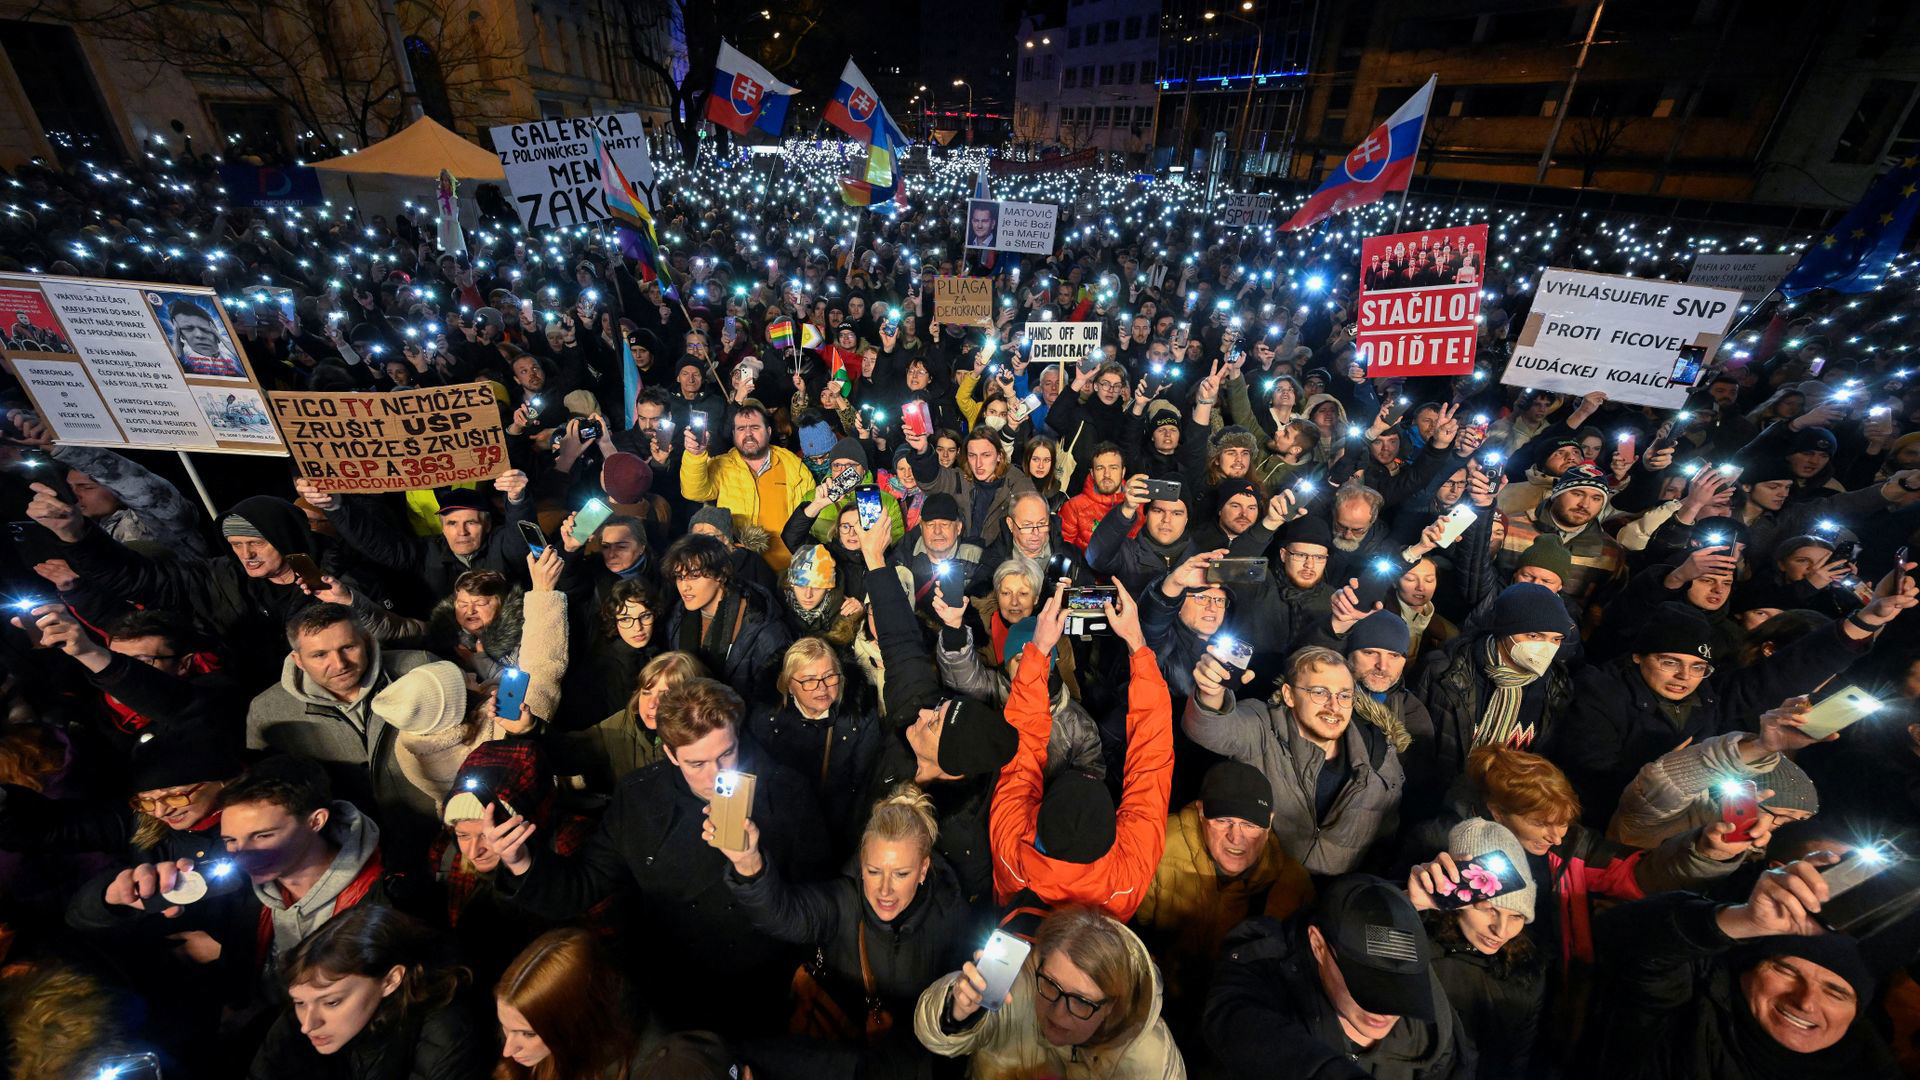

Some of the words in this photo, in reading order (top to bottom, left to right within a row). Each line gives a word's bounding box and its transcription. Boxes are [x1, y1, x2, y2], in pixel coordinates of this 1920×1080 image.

[499, 151, 511, 165] Z
[604, 136, 640, 150] HATY
[548, 158, 601, 188] MEN
[517, 180, 656, 232] ZÁKY
[1229, 194, 1246, 207] SME
[1247, 195, 1254, 207] V
[1002, 217, 1011, 227] je
[1014, 219, 1028, 228] bič
[1014, 240, 1045, 250] SMER
[1017, 230, 1050, 240] MAFIU
[1695, 263, 1717, 271] MAFIA
[937, 279, 988, 295] PLIAGA
[936, 305, 990, 317] DEMOKRACIU
[954, 295, 967, 304] ZA
[1361, 292, 1477, 327] STAČILO!
[1546, 281, 1669, 308] VYHLASUJEME
[1672, 298, 1727, 319] SNP
[109, 308, 120, 316] DO
[1028, 326, 1052, 340] HANDS
[1059, 326, 1075, 340] OFF
[1083, 326, 1098, 340] OUR
[1546, 322, 1601, 340] PROTI
[1610, 330, 1687, 351] FICOVEJ
[95, 348, 110, 356] VÁS
[1360, 335, 1472, 367] ODÍĎTE!
[137, 370, 152, 378] VÁS
[1515, 355, 1598, 378] ĽUDÁCKEJ
[273, 398, 338, 417] FICO
[340, 398, 374, 417] TY
[380, 384, 494, 417] NEMÔŽEŠ
[290, 418, 385, 439] ZRUŠIŤ
[401, 412, 473, 435] ÚŠP
[293, 441, 324, 458] TY
[330, 437, 421, 458] MÔŽEŠ
[423, 426, 501, 454] ZRUŠIŤ
[301, 460, 339, 477] IBA
[339, 460, 379, 478] GP
[386, 460, 400, 477] A
[401, 453, 456, 476] 363
[472, 445, 502, 466] 79
[307, 478, 408, 491] ZRADCOVIA
[409, 474, 431, 487] DO
[435, 466, 489, 483] RUSKA
